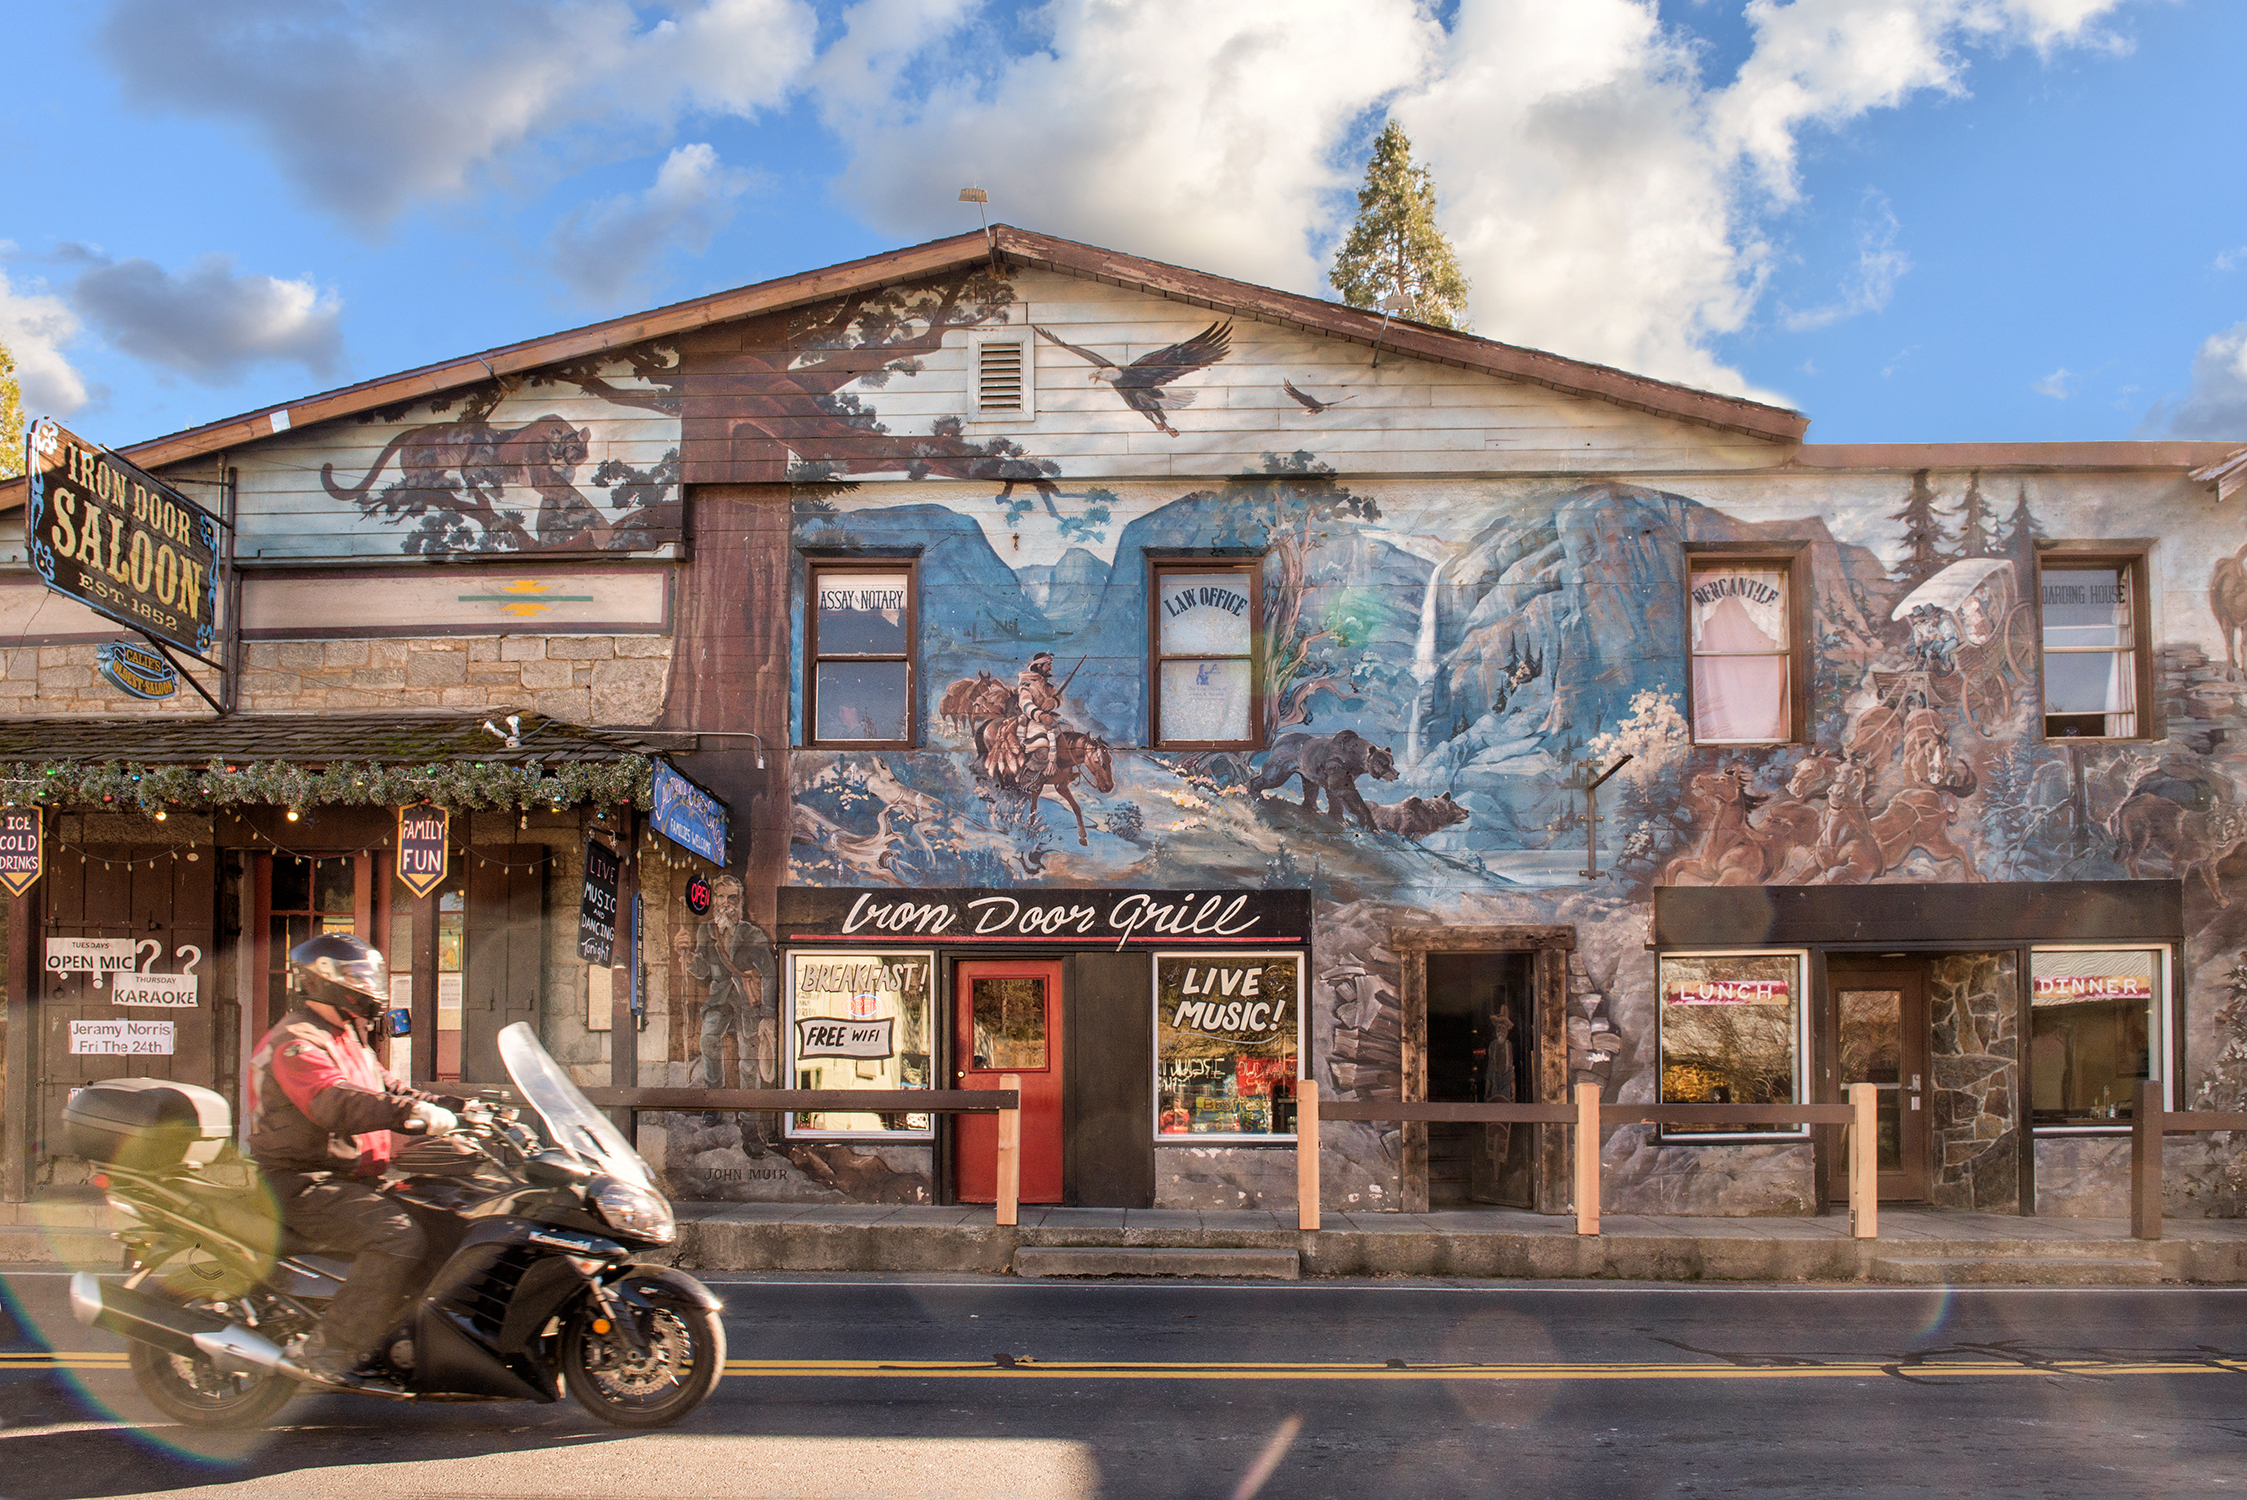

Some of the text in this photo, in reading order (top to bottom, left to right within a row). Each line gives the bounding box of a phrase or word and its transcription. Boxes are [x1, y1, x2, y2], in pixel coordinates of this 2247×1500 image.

[66, 441, 191, 548] IRON DOOR
[51, 487, 204, 622] SALOON
[820, 590, 855, 610] ASSAY
[860, 590, 904, 610] NOTARY
[1163, 586, 1248, 617] LAW OFFICE
[1691, 577, 1779, 608] MERCANTILE
[2041, 584, 2126, 605] OARDING HOUSE
[7, 816, 32, 831] ICE
[403, 820, 445, 840] FAMILY
[0, 834, 37, 851] COLD
[691, 831, 712, 855] WELCOME
[0, 855, 39, 870] DRINKS
[402, 849, 442, 872] FUN
[590, 855, 616, 885] LIVE
[583, 881, 617, 914] MUSIC
[691, 883, 711, 907] OPEN
[593, 908, 606, 920] AND
[842, 892, 1261, 952] Iron Door Grill
[581, 913, 615, 942] DANCING
[72, 941, 110, 950] TUESDAYS
[47, 955, 133, 970] OPEN MIC
[136, 976, 177, 985] THURSDAY
[801, 963, 929, 993] BREAKFAST!
[1181, 966, 1263, 997] LIVE
[2039, 978, 2138, 994] DINNER
[115, 989, 195, 1005] KARAOKE
[1680, 983, 1773, 1001] LUNCH
[1171, 999, 1287, 1032] MUSIC!
[72, 1023, 171, 1038] Jeramy Norris
[806, 1026, 847, 1047] FREE
[79, 1041, 163, 1053] Fri The 24th
[1202, 1097, 1238, 1111] BEST
[1206, 1120, 1261, 1132] FORST
[704, 1168, 788, 1181] JOHN MUIR
